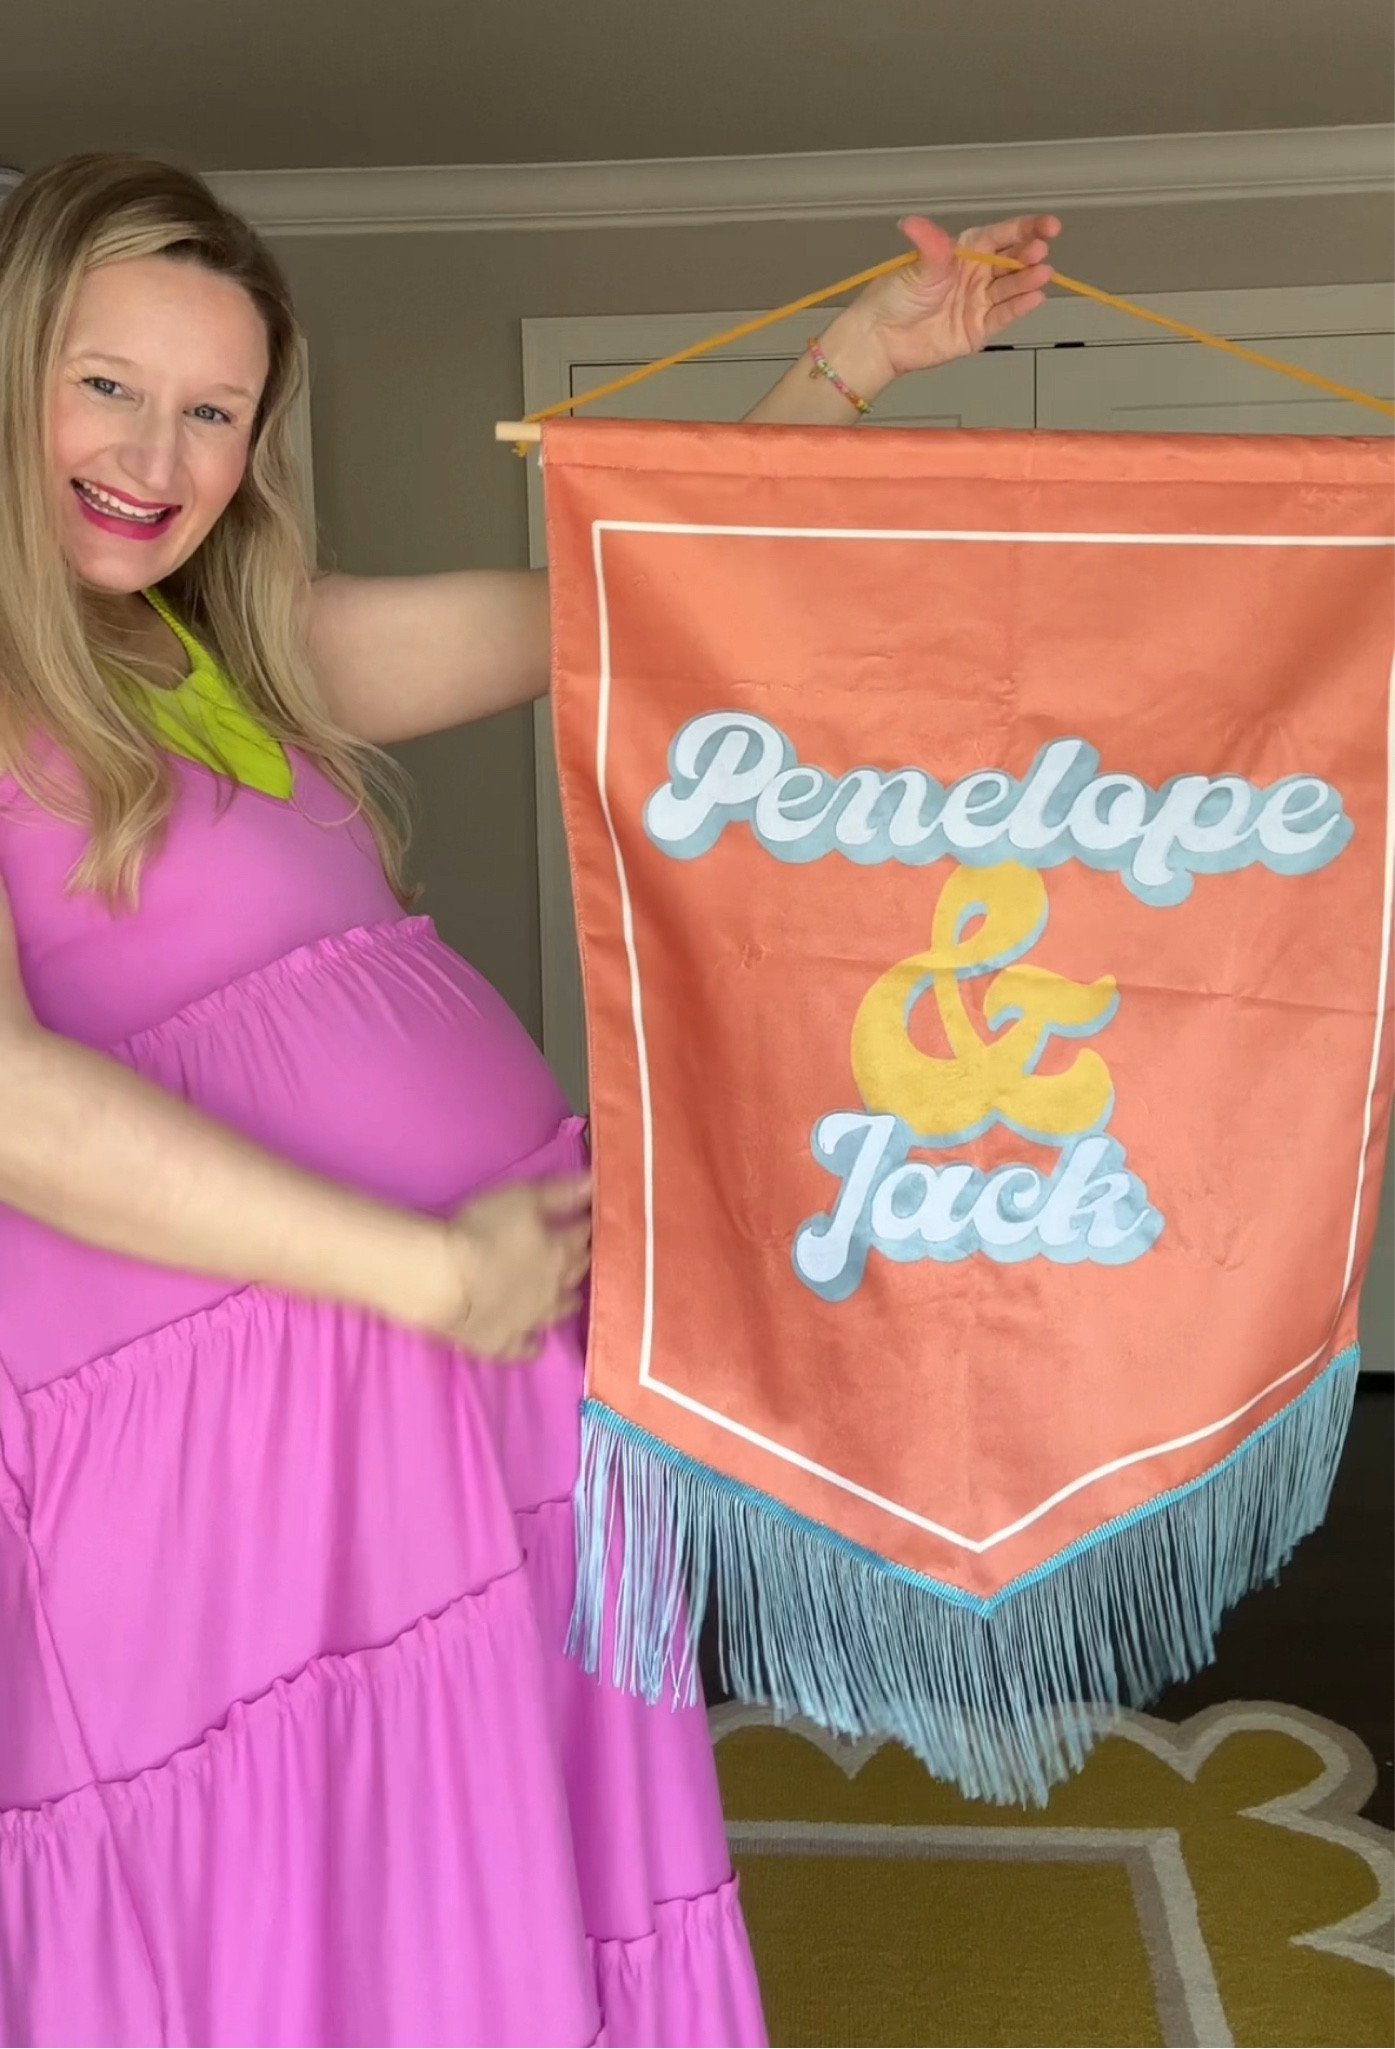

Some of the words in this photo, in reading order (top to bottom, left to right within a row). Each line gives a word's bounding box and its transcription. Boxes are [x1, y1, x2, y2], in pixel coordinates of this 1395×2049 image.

[644, 709, 1354, 906] Penelope
[851, 860, 1119, 1146] &
[791, 1111, 1164, 1300] Jack
